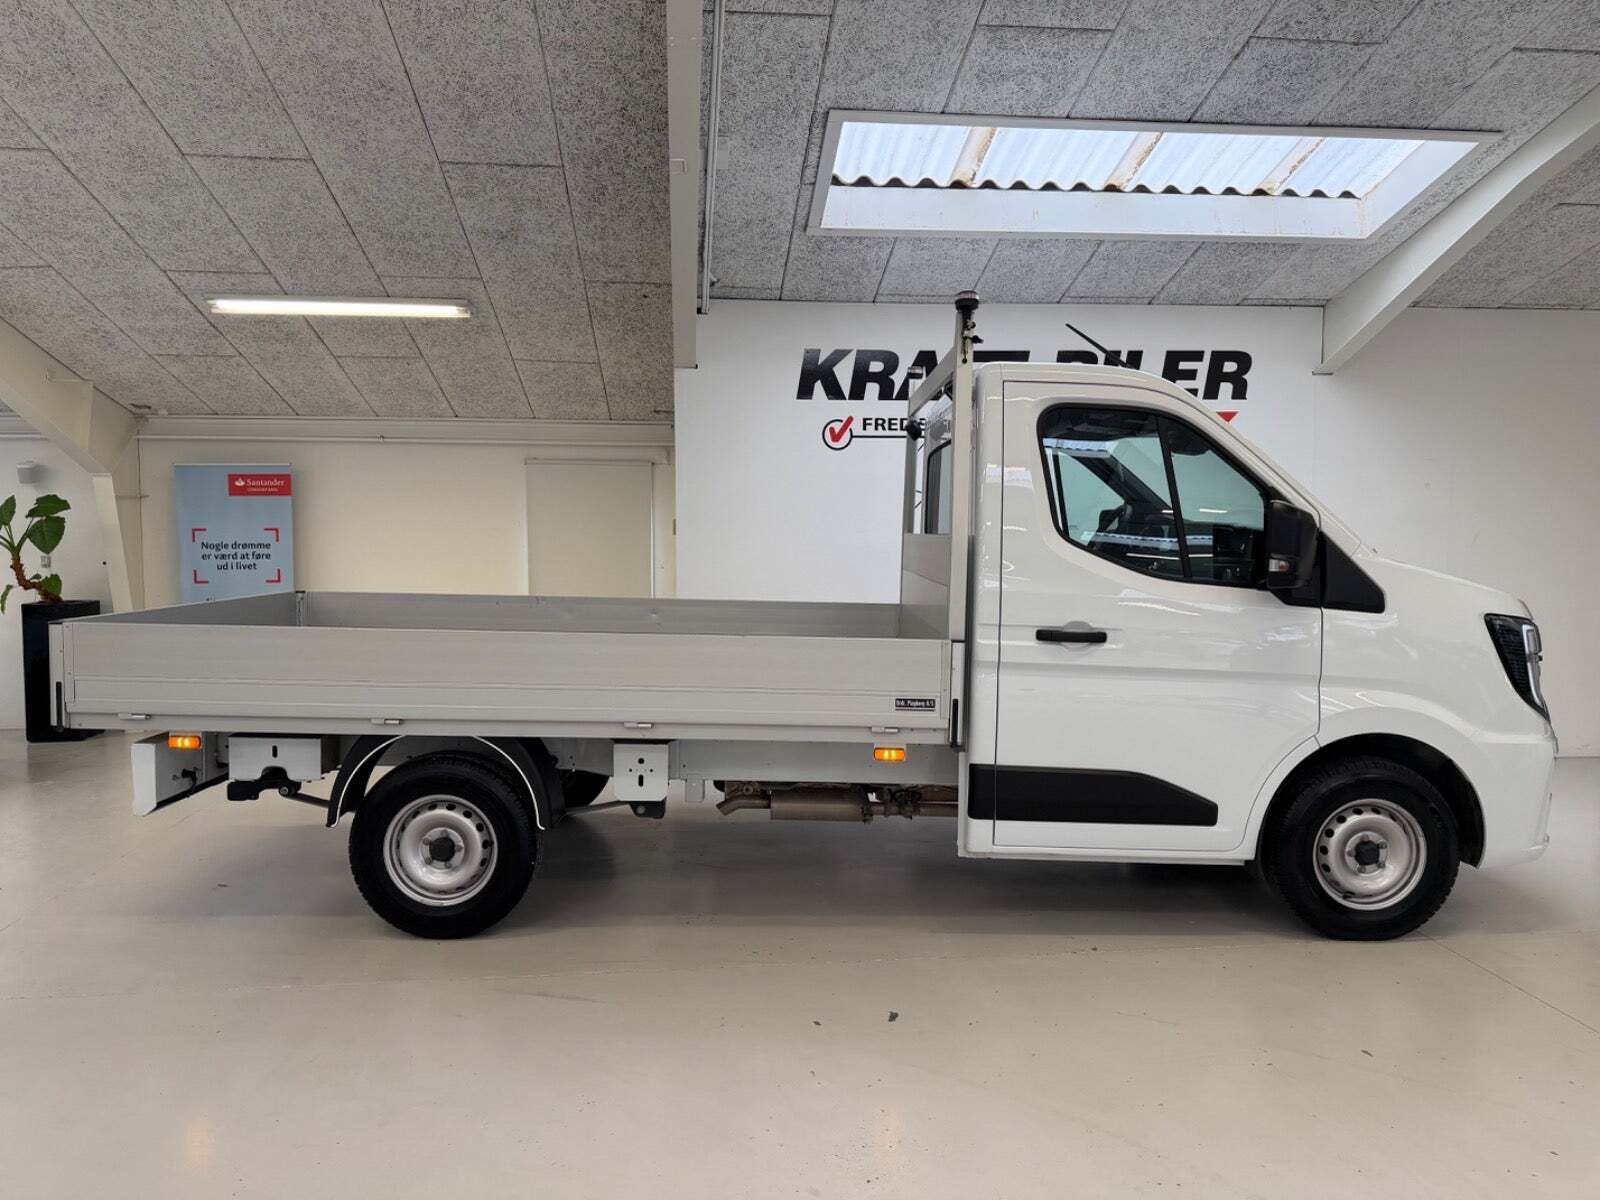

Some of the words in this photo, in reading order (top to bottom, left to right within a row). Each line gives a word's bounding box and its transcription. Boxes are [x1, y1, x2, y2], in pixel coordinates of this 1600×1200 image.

[246, 478, 285, 487] Santander
[201, 541, 229, 552] Nogle
[231, 541, 271, 550] drømme
[214, 551, 238, 560] værd
[251, 551, 271, 560] føre
[217, 562, 228, 570] ud
[236, 562, 257, 570] livet
